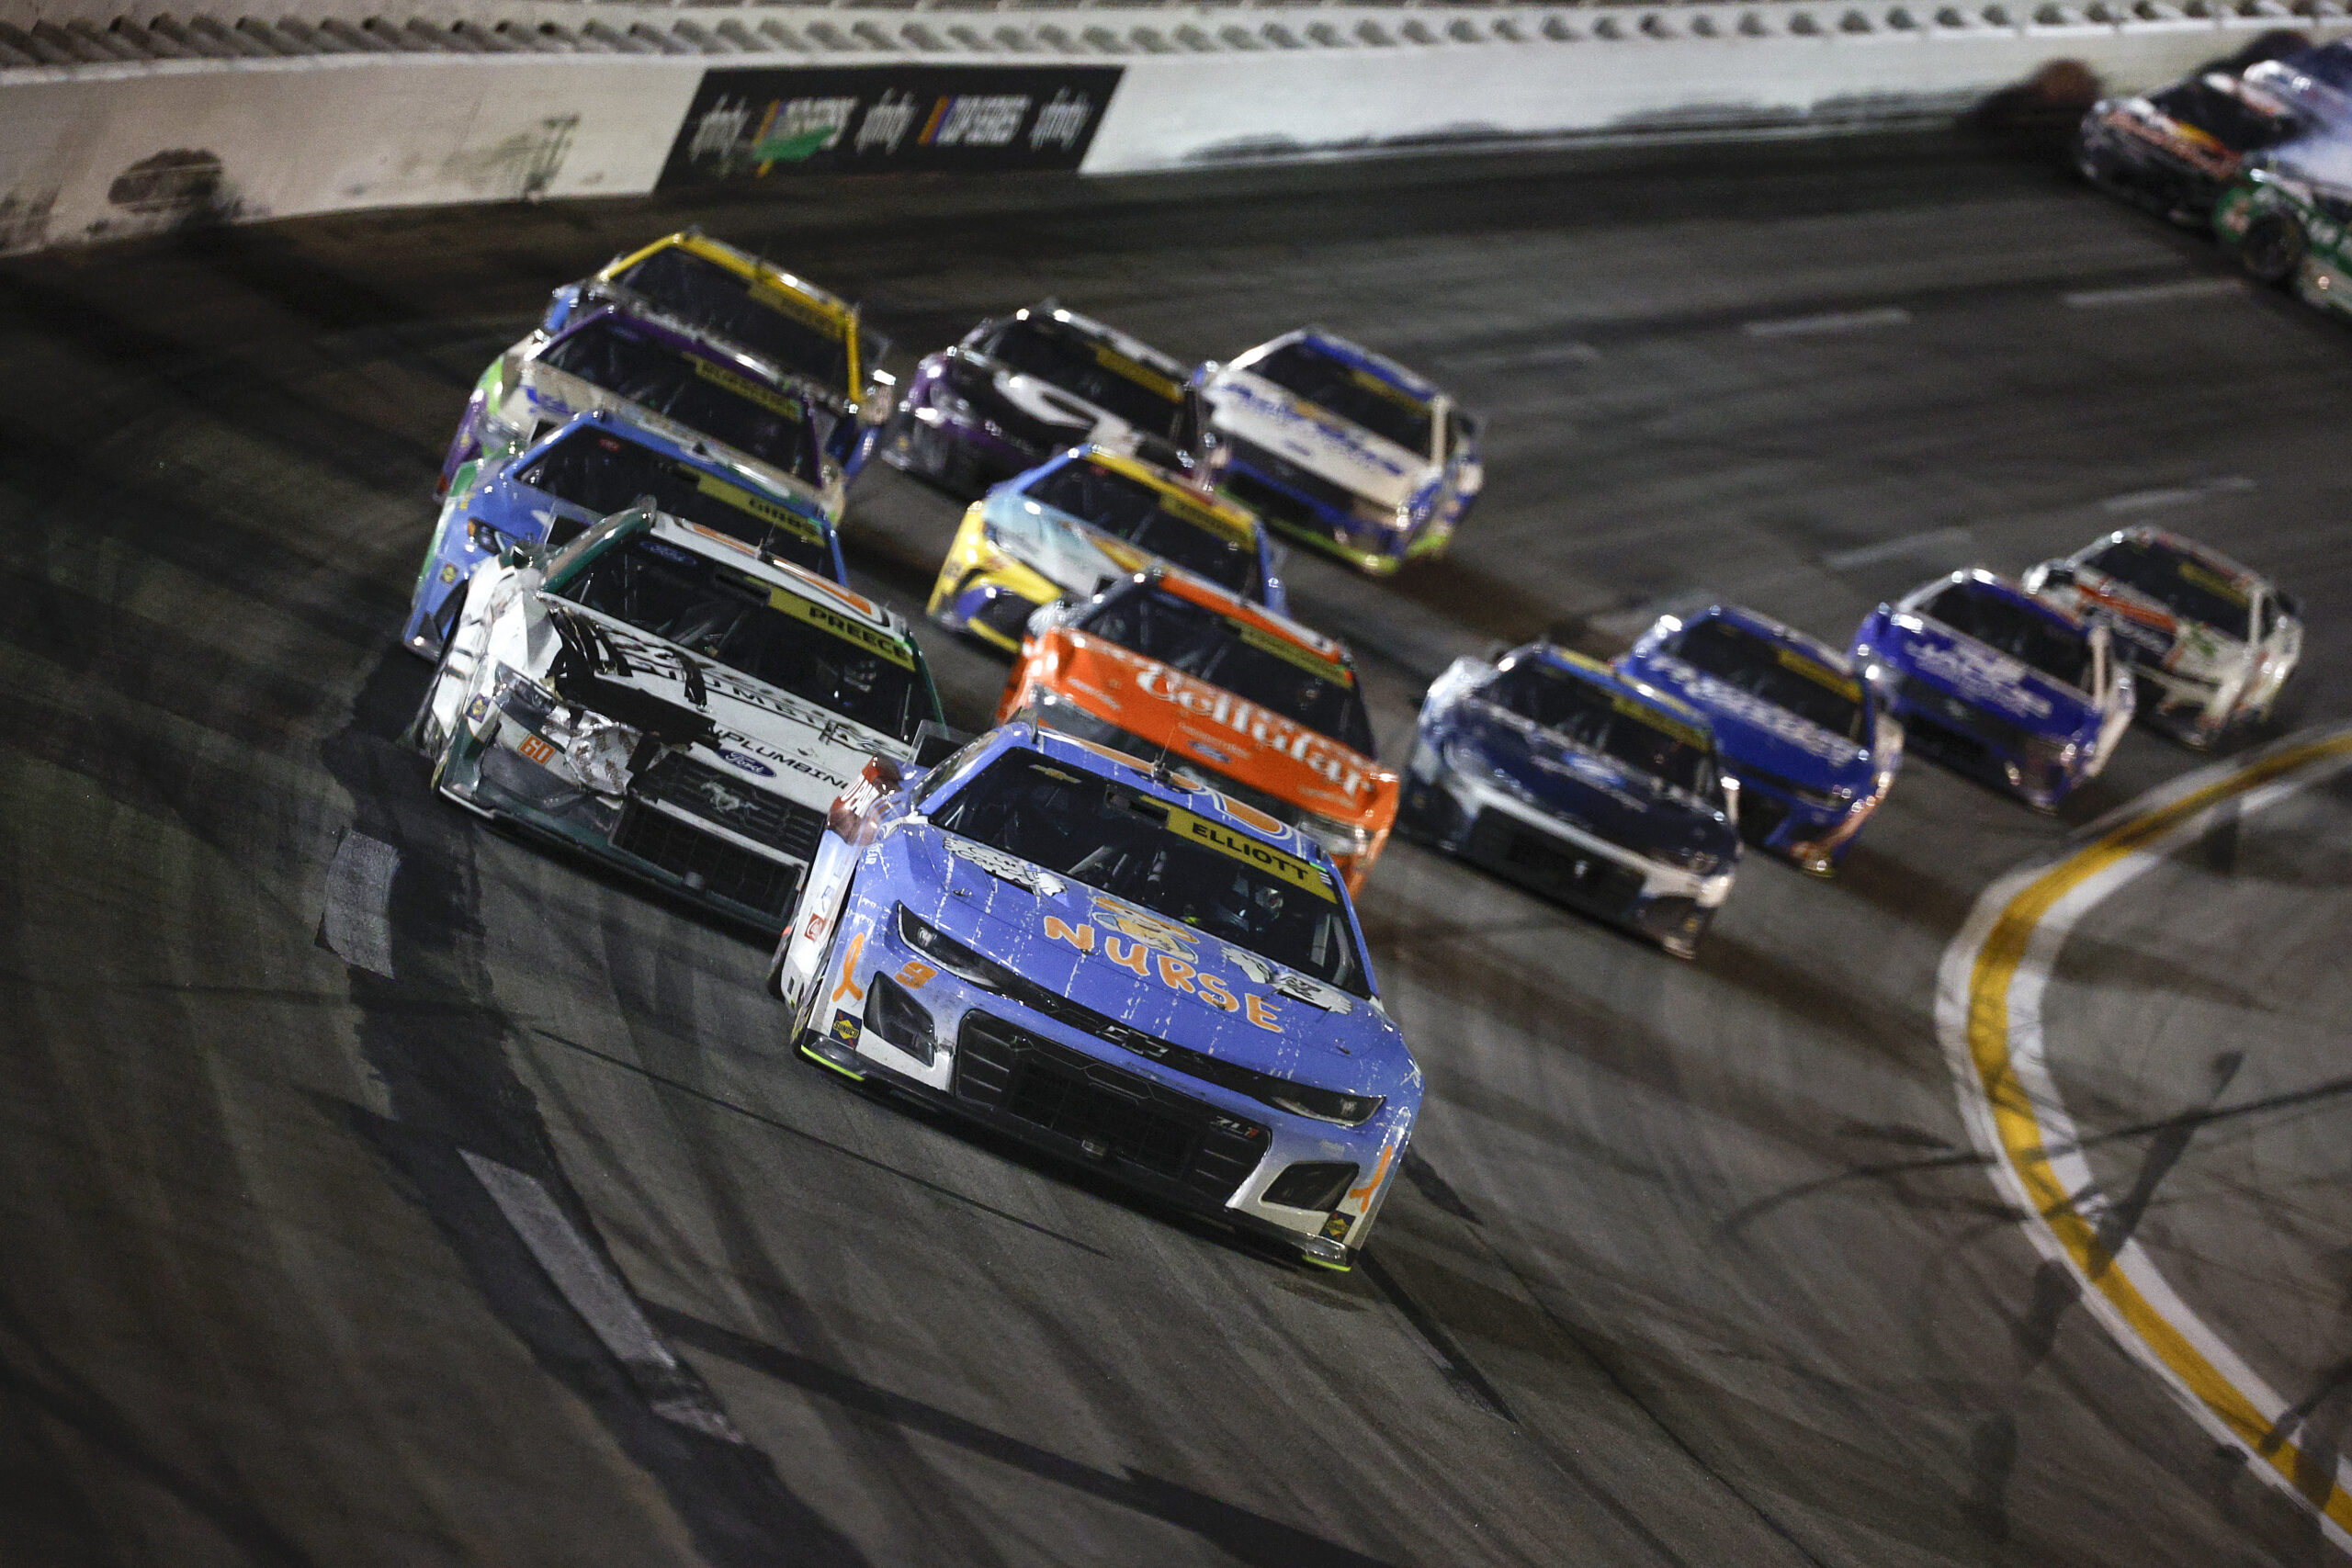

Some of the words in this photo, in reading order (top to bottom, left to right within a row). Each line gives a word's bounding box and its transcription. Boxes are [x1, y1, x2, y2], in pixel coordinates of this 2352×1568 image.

[809, 605, 912, 660] PREECE
[517, 734, 556, 766] 60
[1193, 822, 1308, 880] ELLIOTT
[894, 961, 947, 989] 9
[1044, 915, 1284, 1033] NURSE
[833, 1020, 859, 1039] SUNOCO
